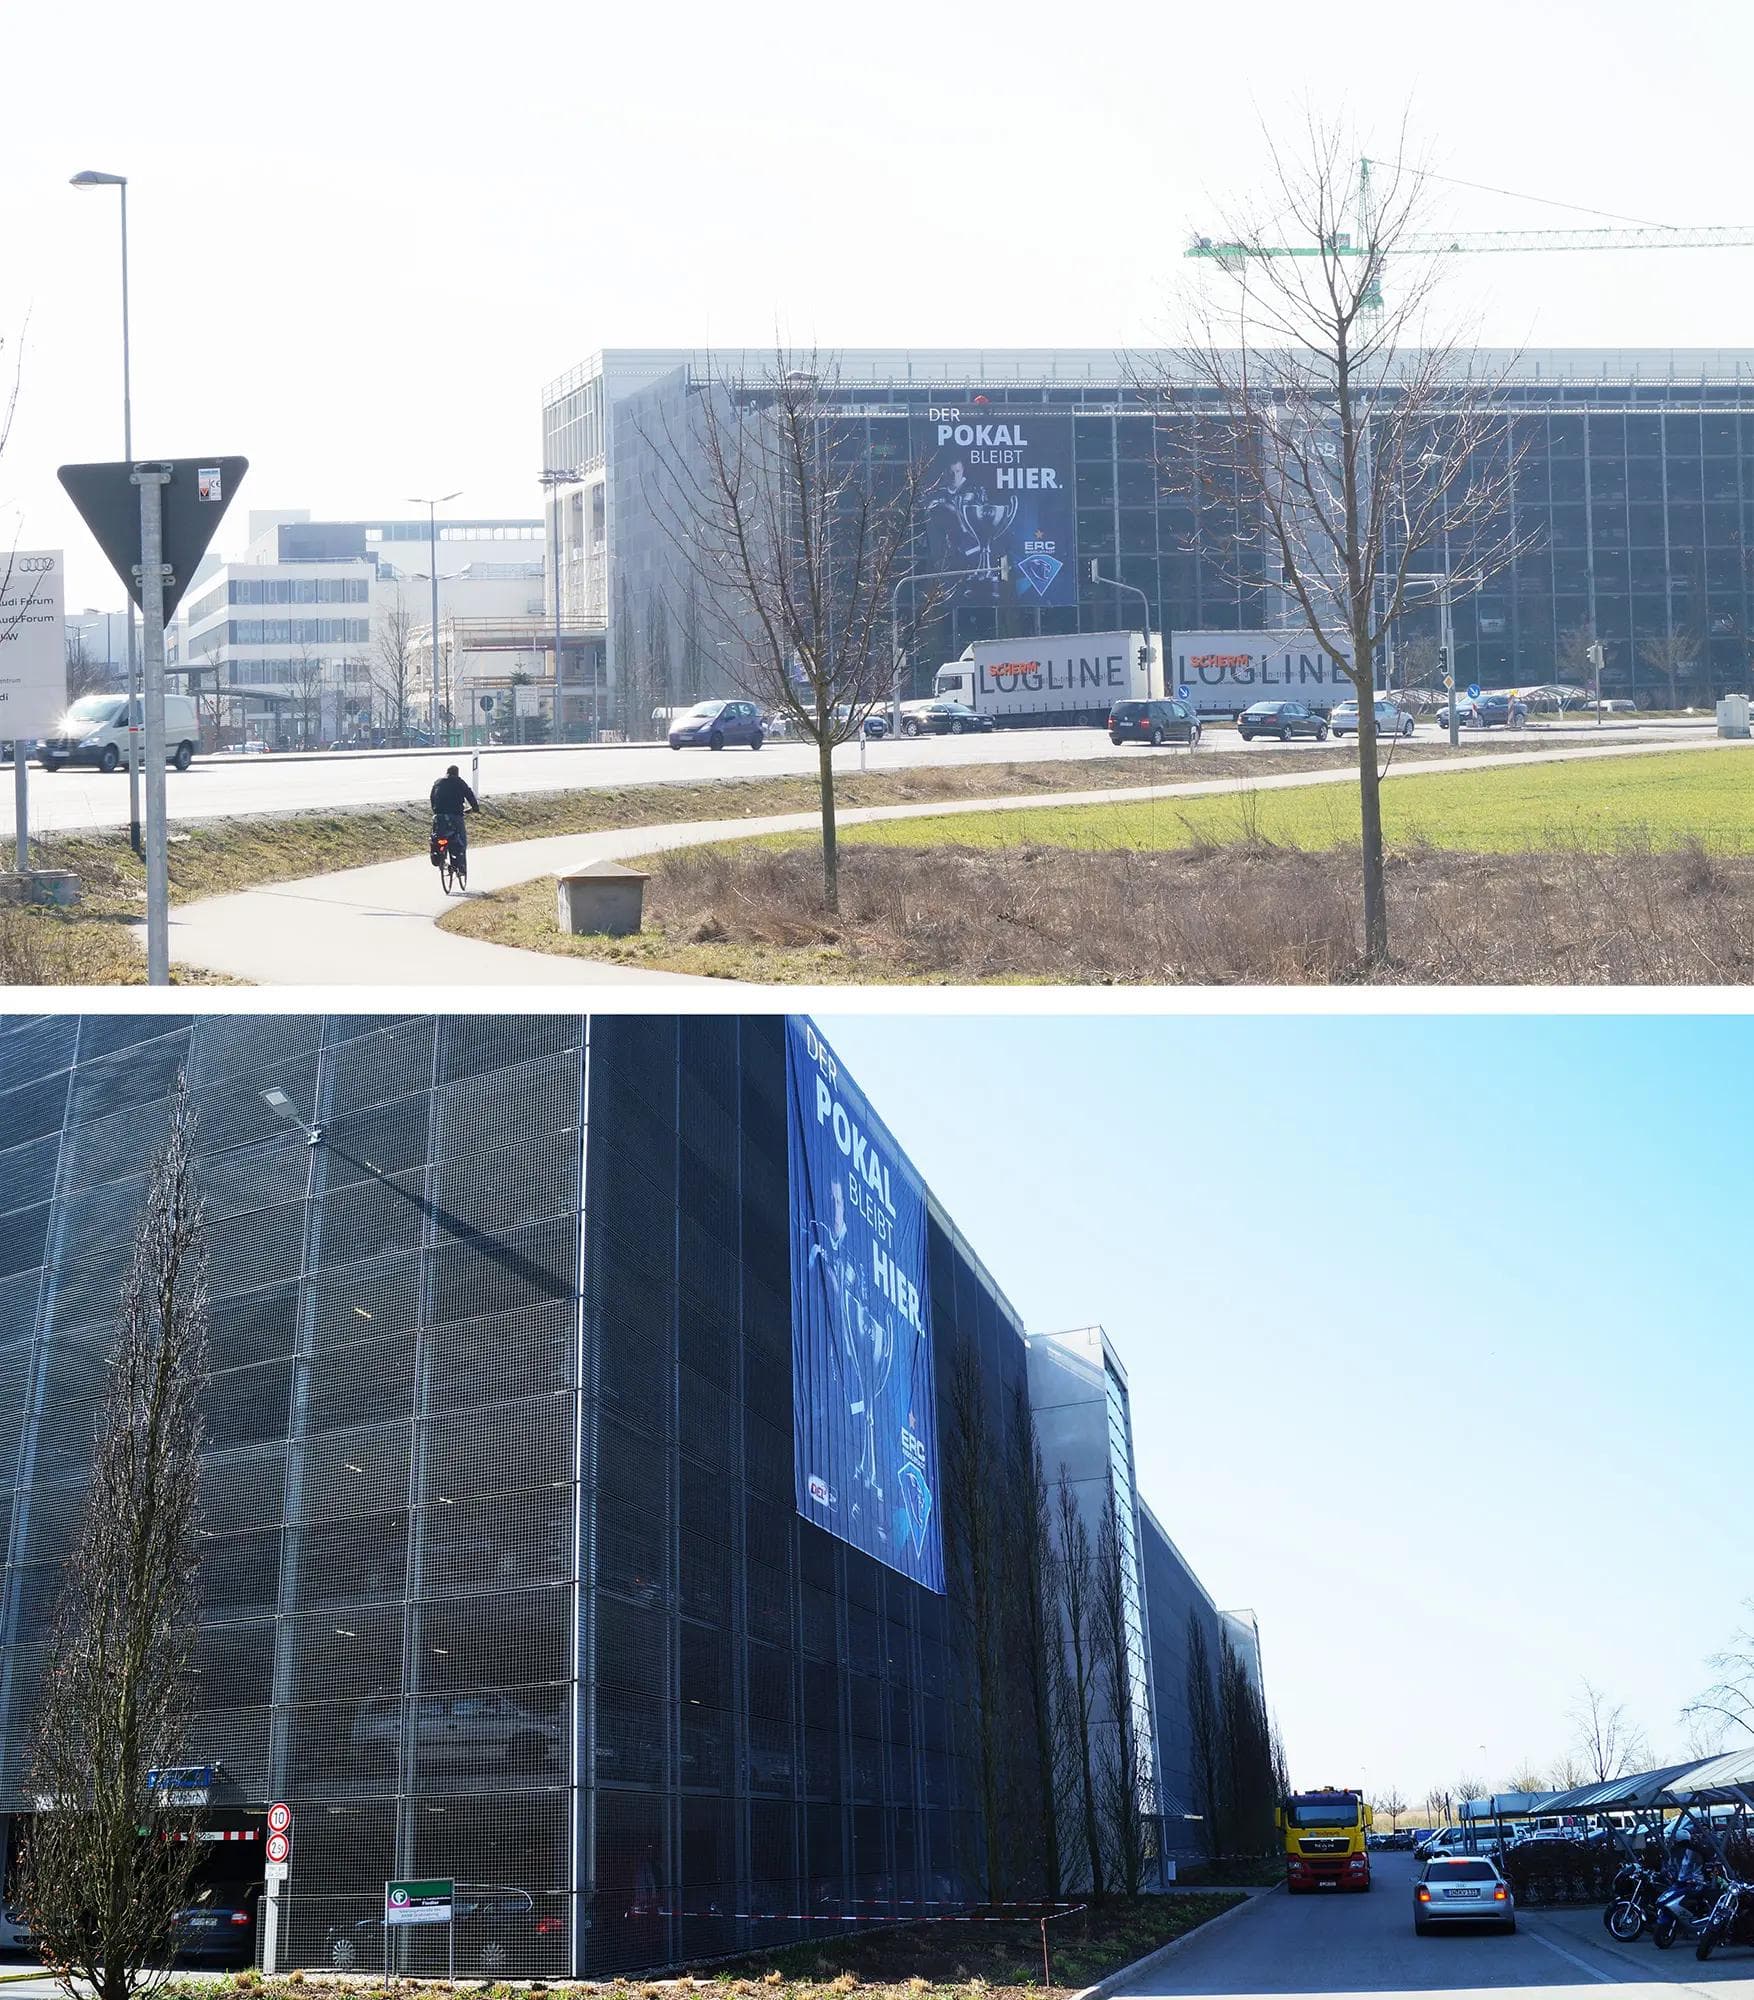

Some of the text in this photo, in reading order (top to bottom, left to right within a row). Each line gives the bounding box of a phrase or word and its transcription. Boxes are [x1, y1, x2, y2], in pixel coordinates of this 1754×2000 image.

[929, 408, 961, 422] DER
[937, 424, 1028, 446] POKAL
[970, 450, 1023, 464] BLEIBT
[996, 467, 1063, 489] HIER.
[1024, 541, 1056, 550] ERC
[0, 597, 54, 606] udi Forum
[21, 615, 55, 623] Forum
[989, 660, 1039, 677] SCHERM
[1179, 653, 1351, 685] LOGLINE
[1190, 655, 1249, 669] SCHERM
[979, 655, 1124, 695] LOGLINE
[806, 1023, 839, 1093] DER
[816, 1073, 897, 1220] POKAL
[849, 1171, 894, 1249] BLEIBT
[872, 1238, 926, 1339] HIER.
[901, 1426, 926, 1462] ERC
[273, 1811, 285, 1825] 10
